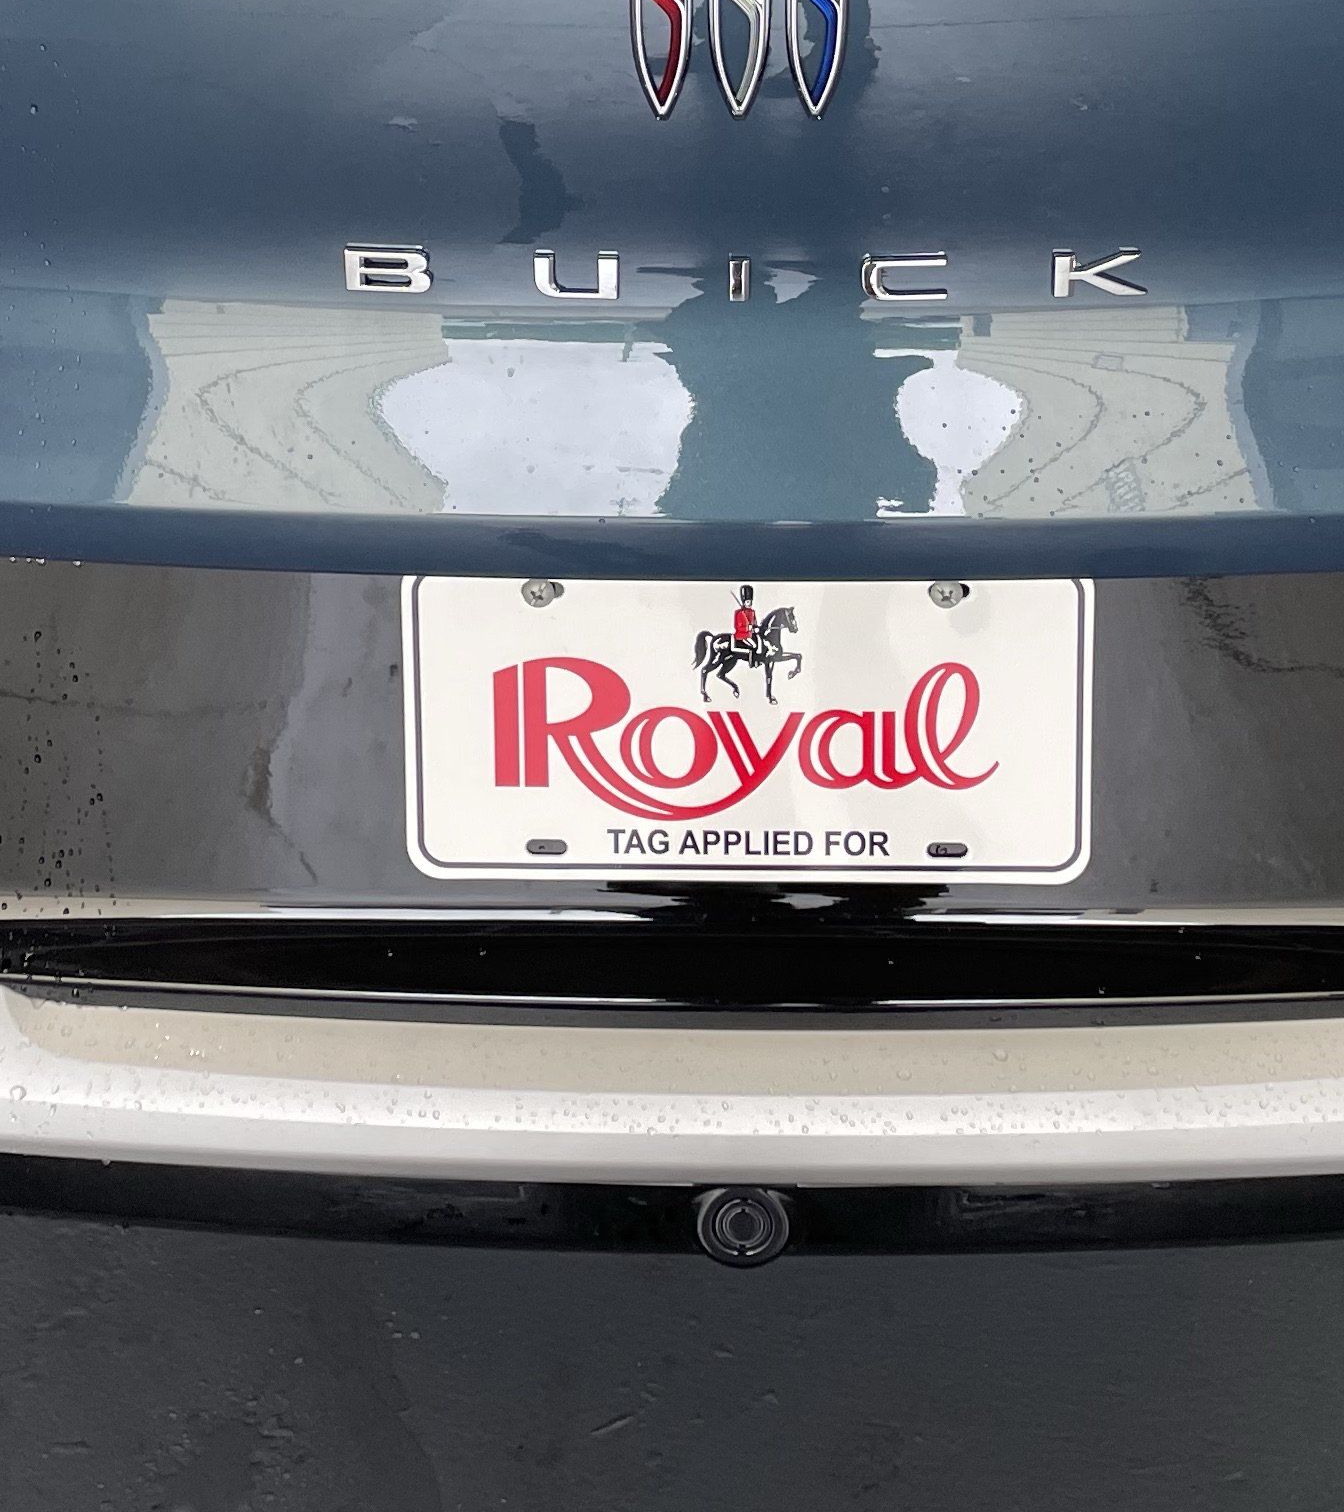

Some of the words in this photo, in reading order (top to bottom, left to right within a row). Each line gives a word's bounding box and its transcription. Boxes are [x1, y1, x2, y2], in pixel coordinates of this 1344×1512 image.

[343, 242, 1148, 302] BUICK
[492, 657, 1000, 822] Royal
[606, 828, 670, 855] TAG
[678, 829, 814, 856] APPLIED
[824, 830, 891, 857] FOR
